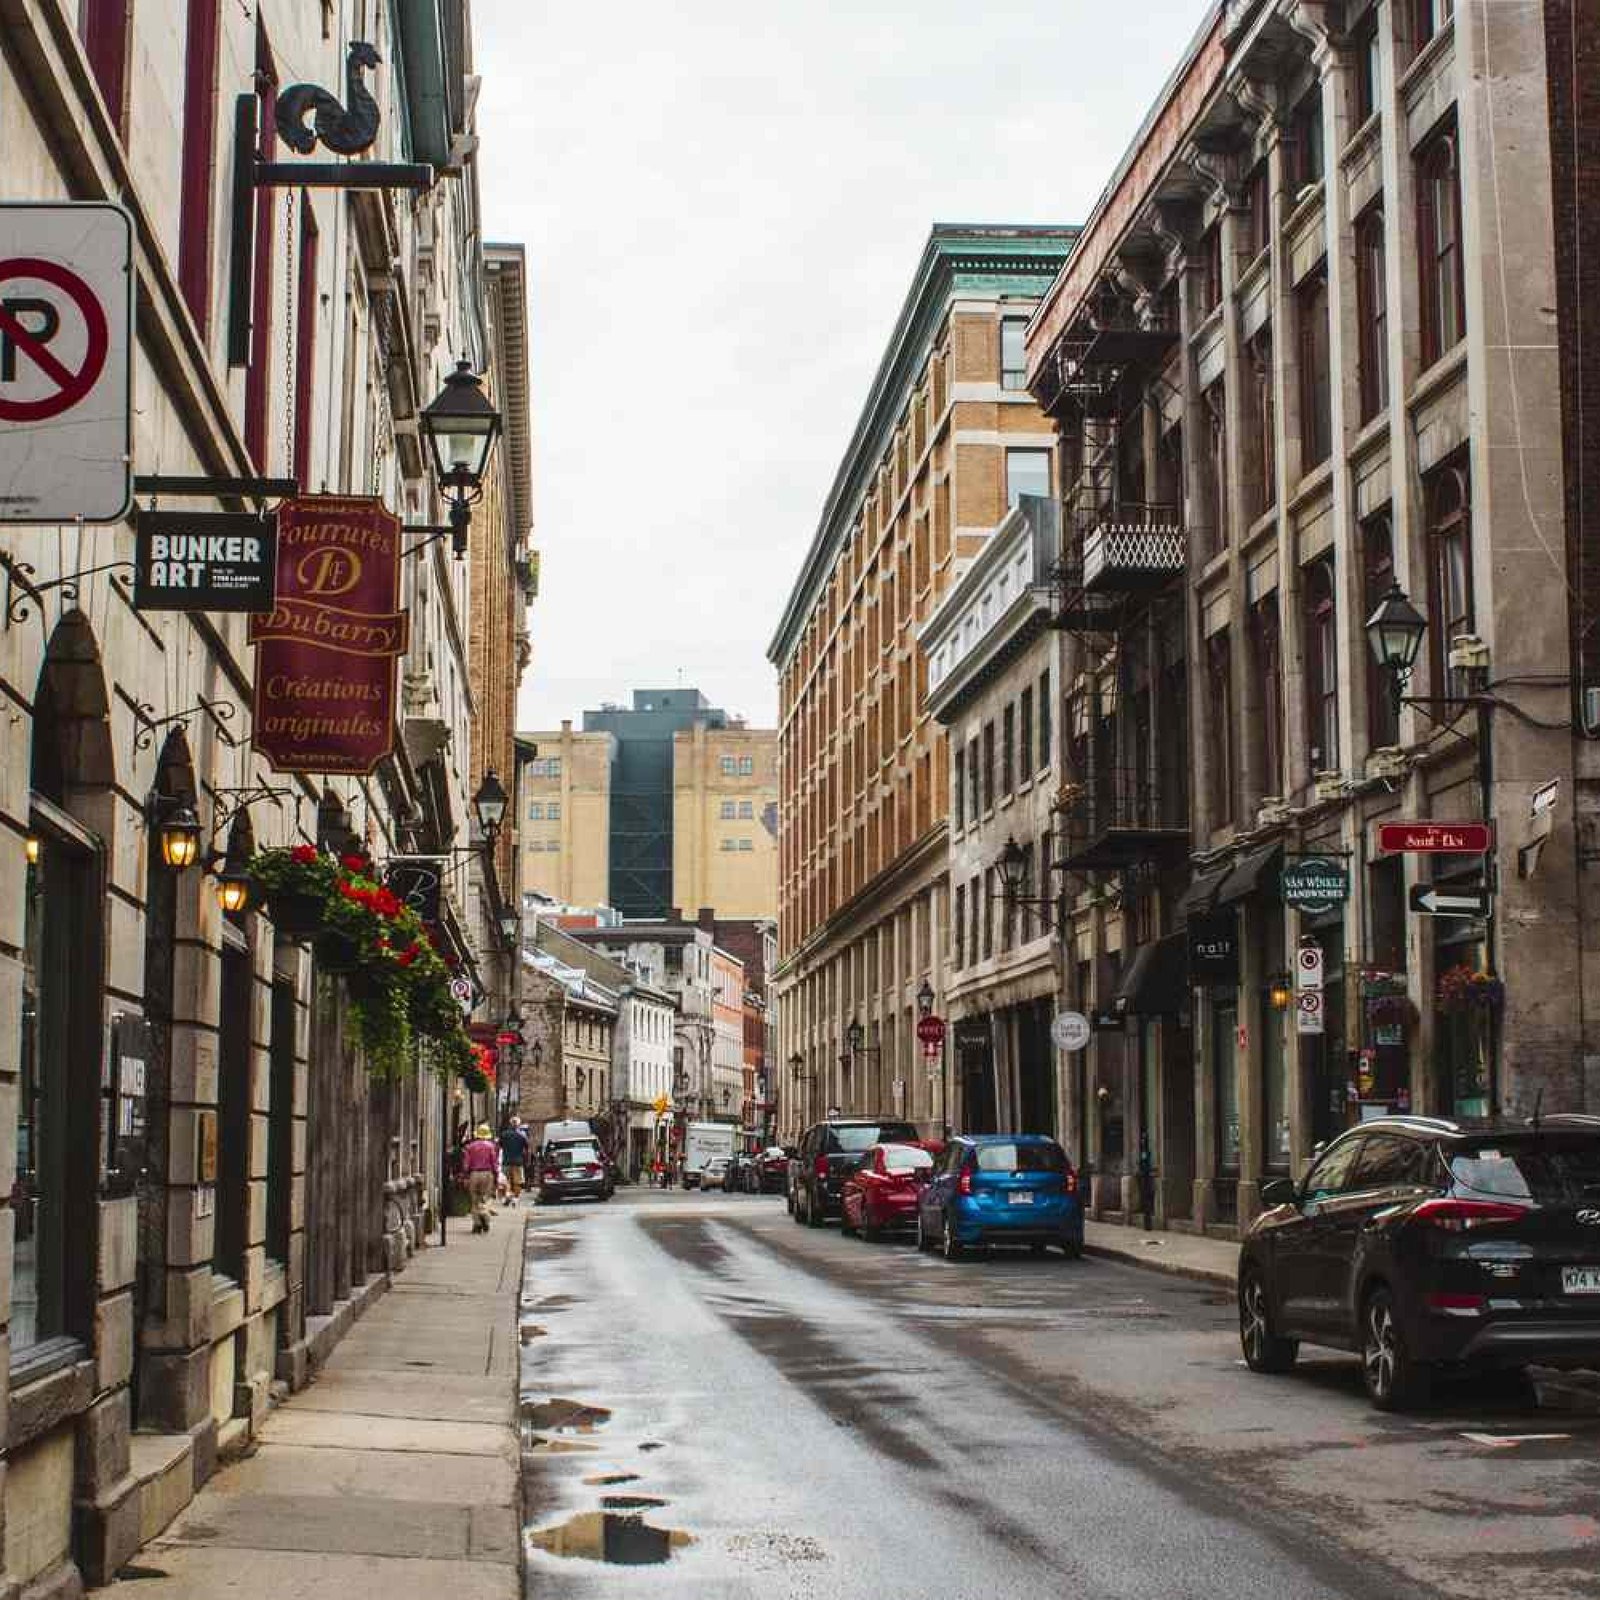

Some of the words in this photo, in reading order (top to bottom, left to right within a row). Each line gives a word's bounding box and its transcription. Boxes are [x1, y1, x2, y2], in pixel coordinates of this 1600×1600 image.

[151, 535, 260, 562] BUNKER
[150, 561, 205, 588] ART
[257, 606, 396, 653] Dubarry
[266, 675, 382, 701] Créations
[265, 711, 382, 743] originales
